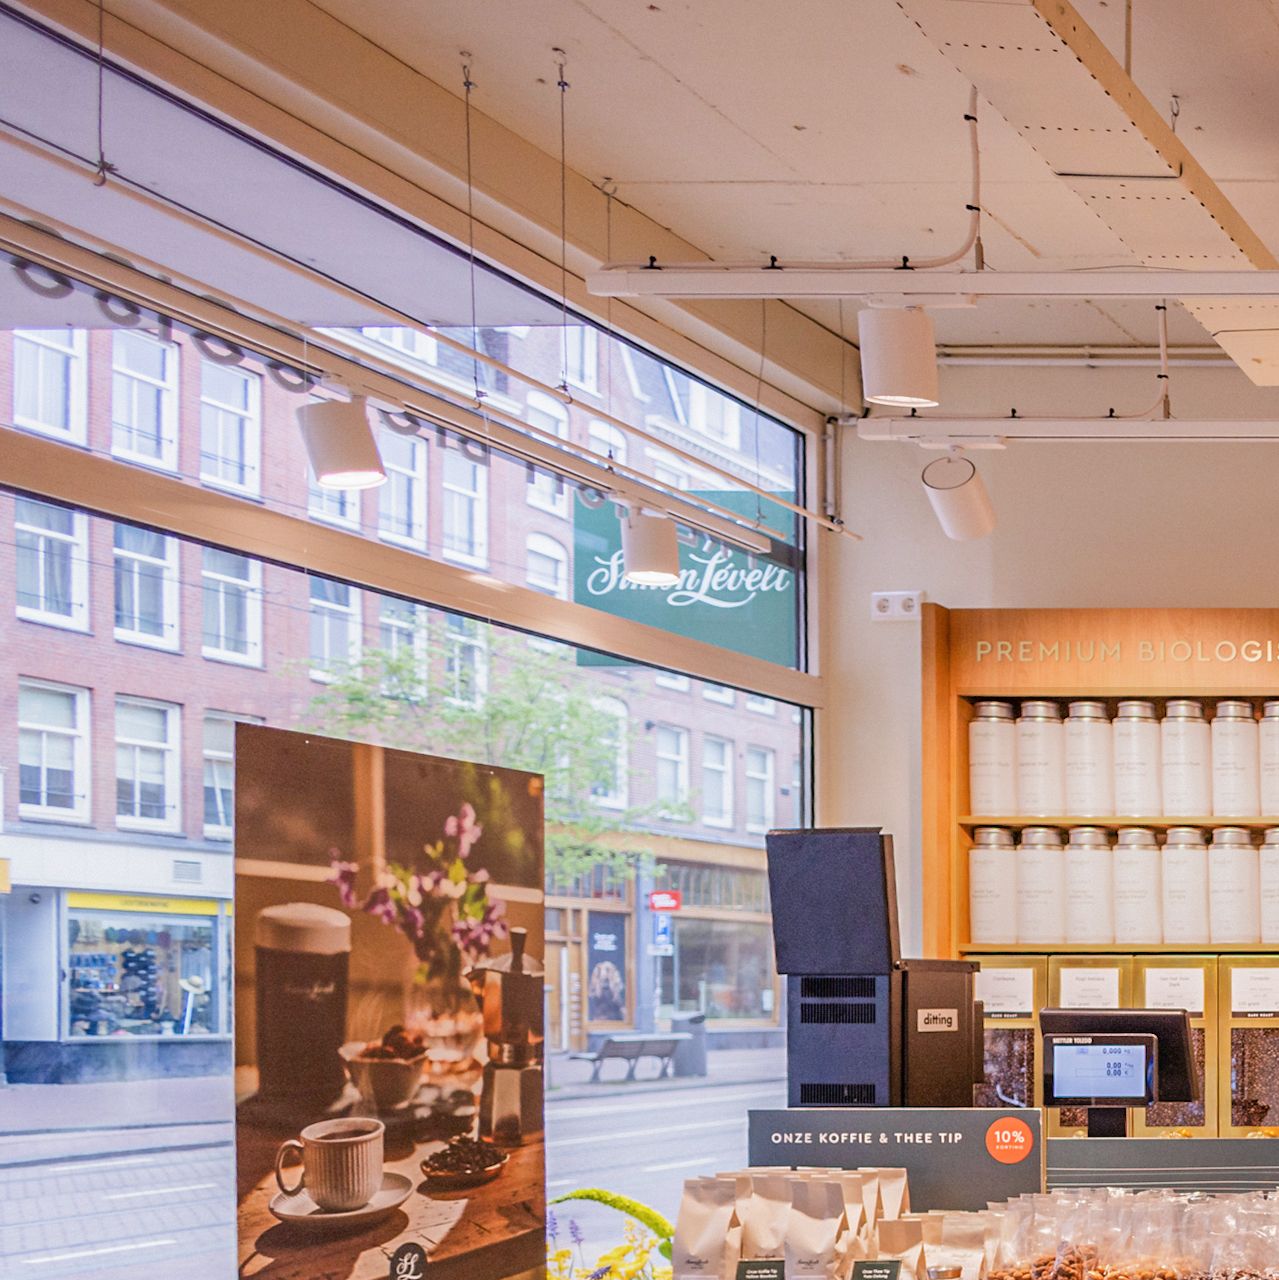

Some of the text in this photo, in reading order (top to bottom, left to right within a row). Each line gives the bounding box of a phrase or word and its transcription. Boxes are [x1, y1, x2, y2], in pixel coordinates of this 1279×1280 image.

[587, 550, 699, 595] Sin
[975, 640, 1121, 662] PREMIUM
[923, 1012, 953, 1028] ditting
[771, 1132, 963, 1144] ONZE KOFFIE & THEE TIP
[994, 1130, 1025, 1143] 10%
